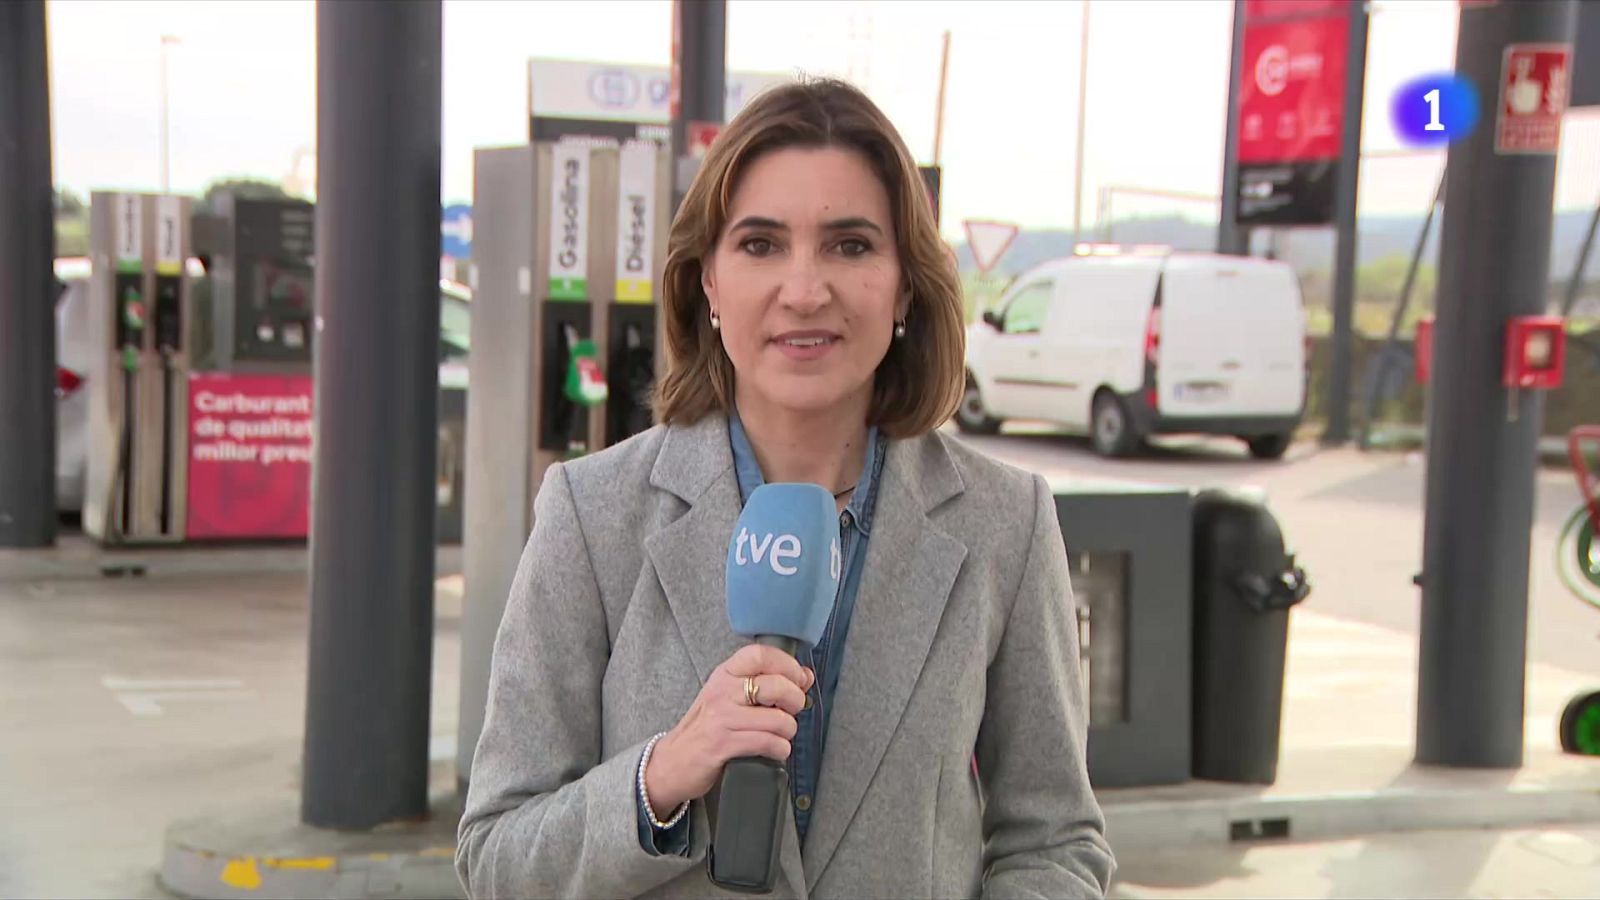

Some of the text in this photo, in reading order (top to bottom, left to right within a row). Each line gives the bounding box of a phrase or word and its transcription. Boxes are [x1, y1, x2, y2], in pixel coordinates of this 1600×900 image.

[559, 159, 579, 269] Gasolina
[194, 391, 309, 414] Carburant
[195, 416, 225, 437] de
[193, 441, 257, 461] millor
[735, 527, 802, 576] tve
